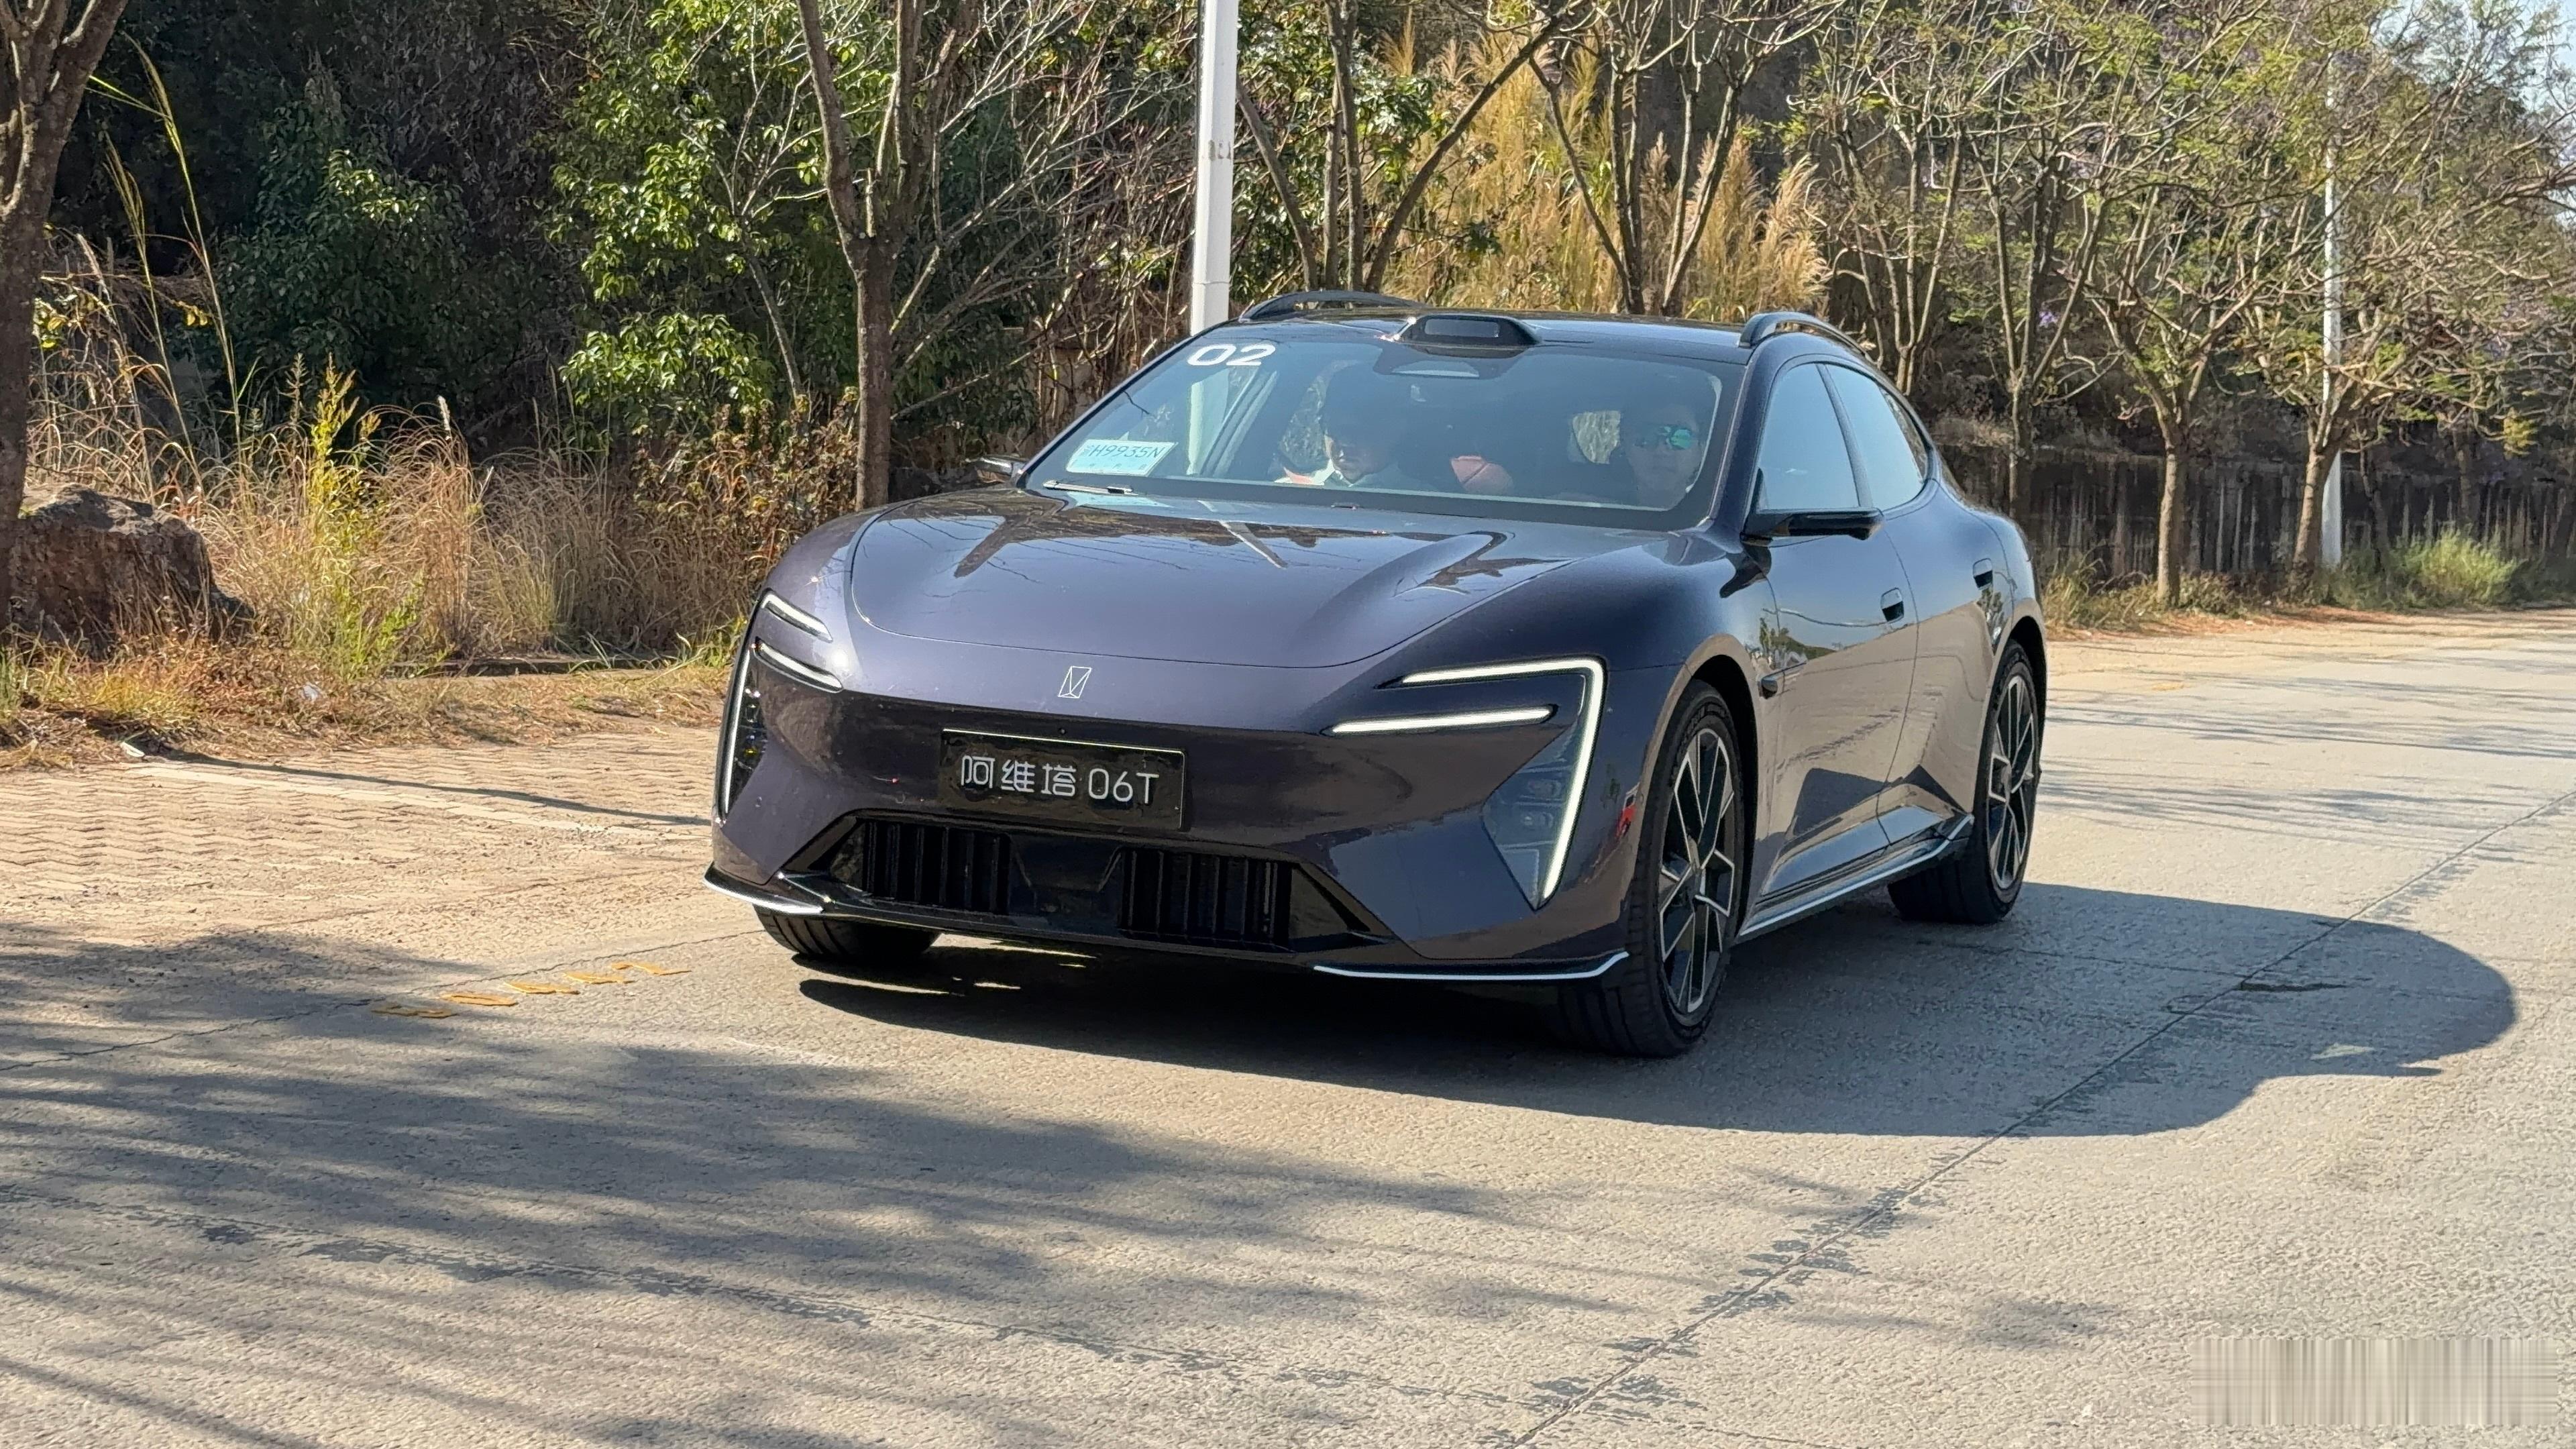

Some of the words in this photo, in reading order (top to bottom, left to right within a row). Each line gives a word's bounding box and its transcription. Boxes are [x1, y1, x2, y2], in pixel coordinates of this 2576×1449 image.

[1187, 343, 1276, 366] 02
[1079, 444, 1165, 458] H9935N
[961, 755, 1077, 797] 阿维塔
[1088, 767, 1160, 804] 06T
